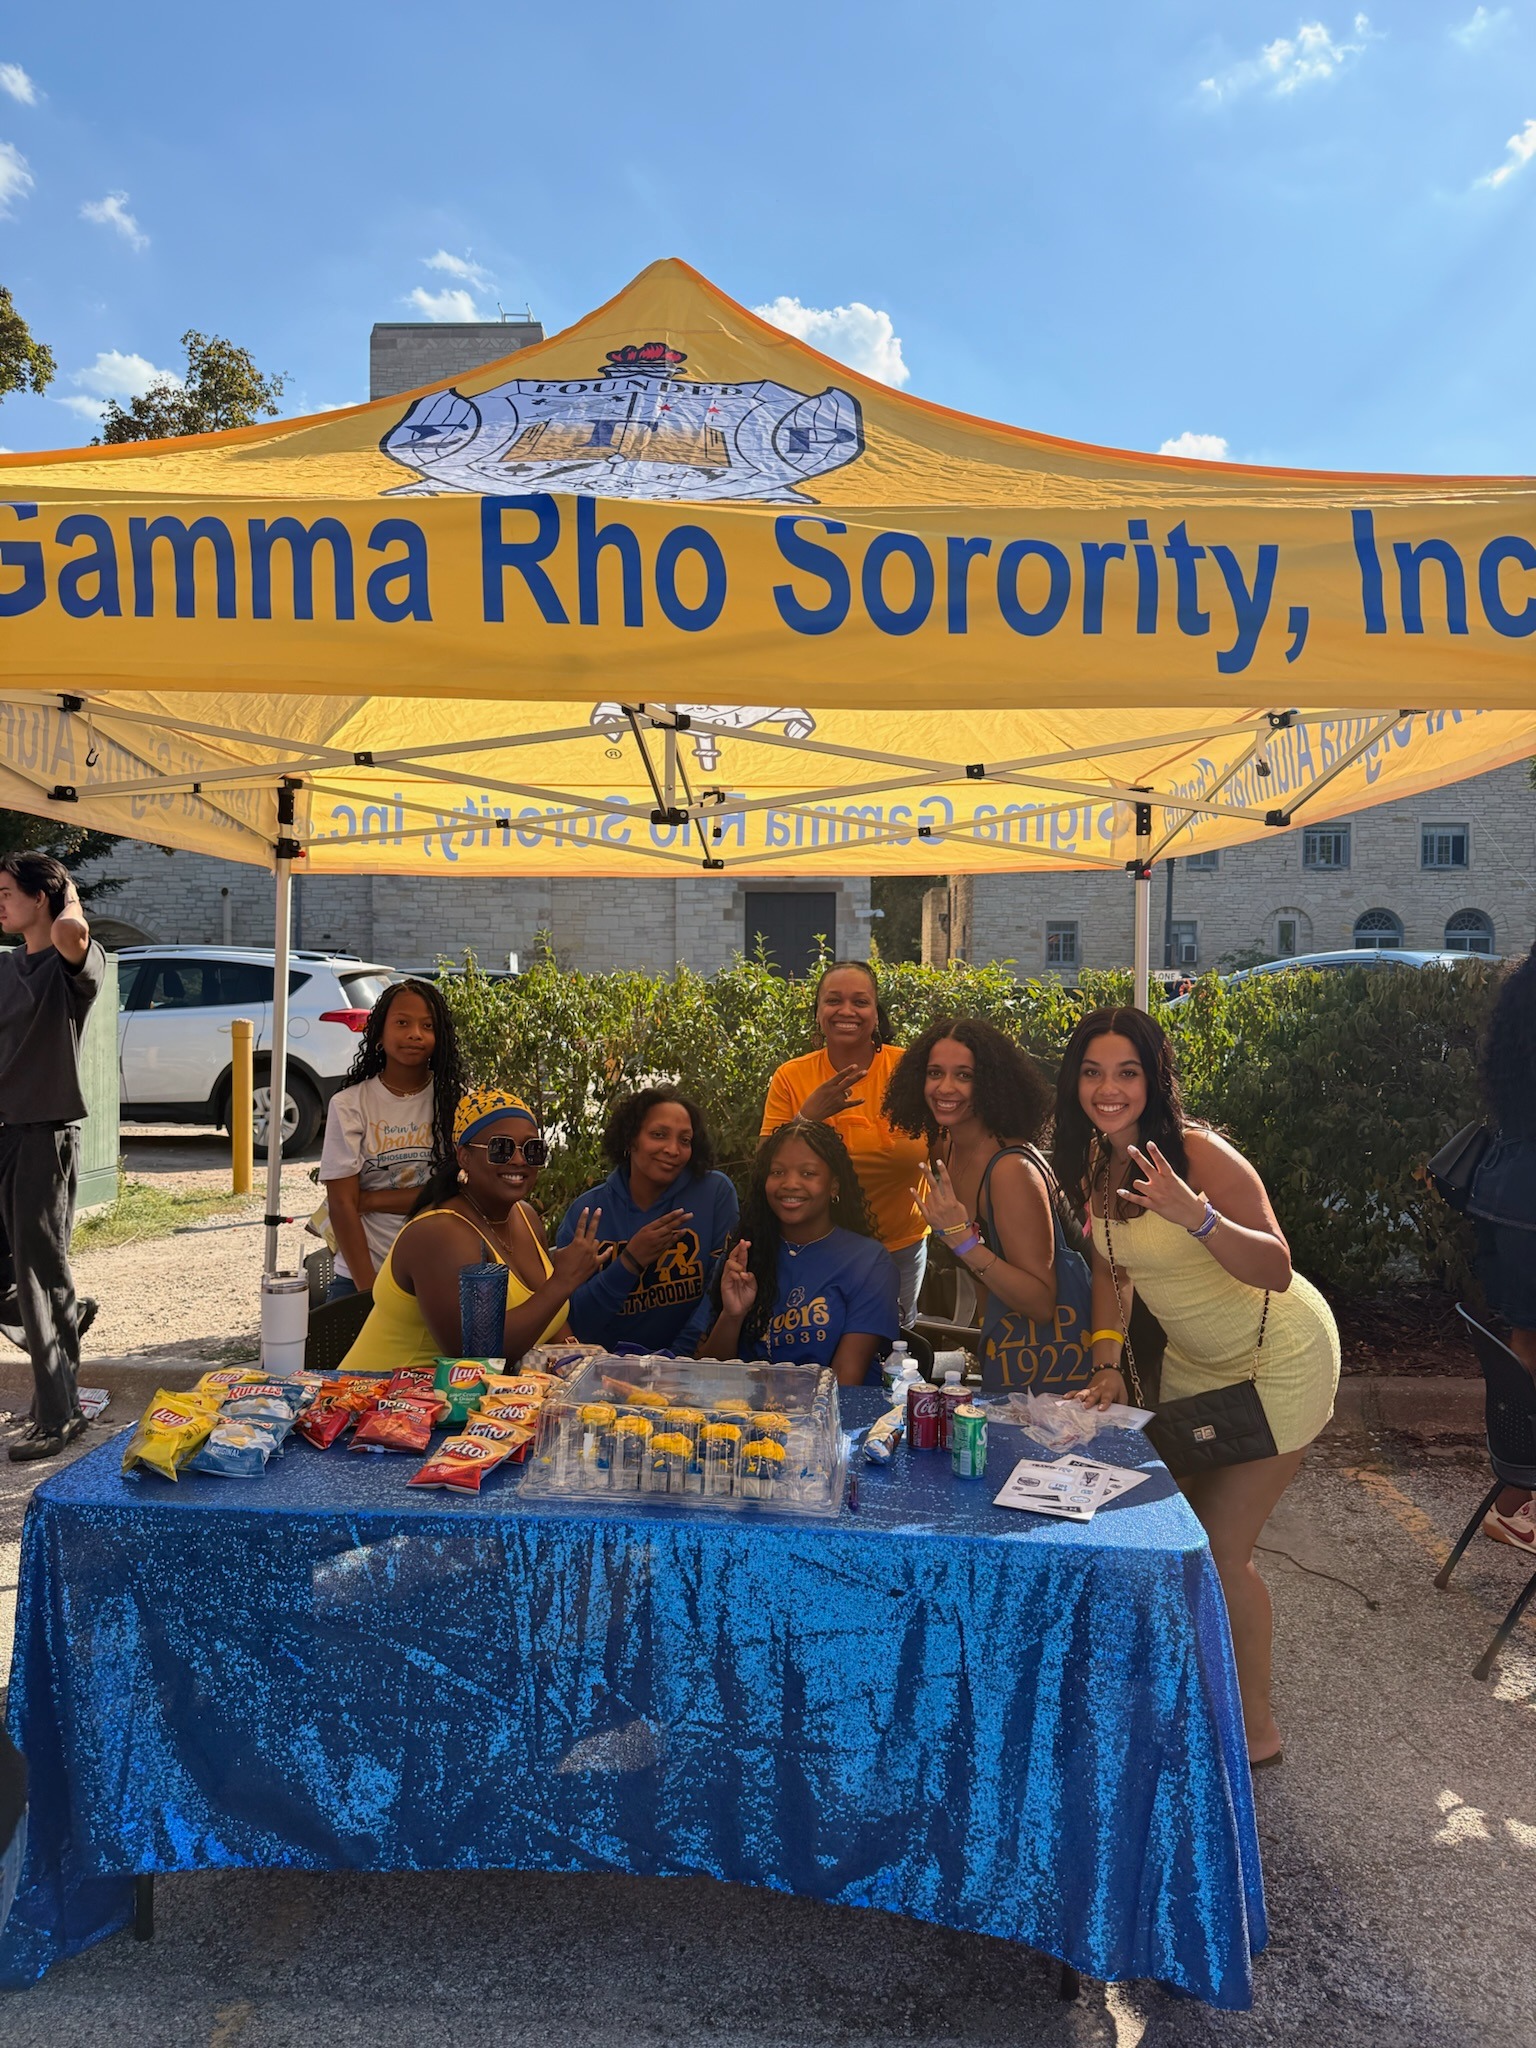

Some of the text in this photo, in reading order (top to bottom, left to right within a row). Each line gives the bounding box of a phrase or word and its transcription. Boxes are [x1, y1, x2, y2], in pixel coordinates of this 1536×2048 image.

[535, 380, 743, 396] FOUNDED
[481, 494, 728, 632] Rho
[773, 514, 1310, 675] Sorority,
[383, 1124, 408, 1135] Born
[775, 1329, 827, 1347] 1939
[997, 1342, 1089, 1387] 1922
[227, 1385, 283, 1400] RUFFLES
[377, 1399, 427, 1415] Doritos
